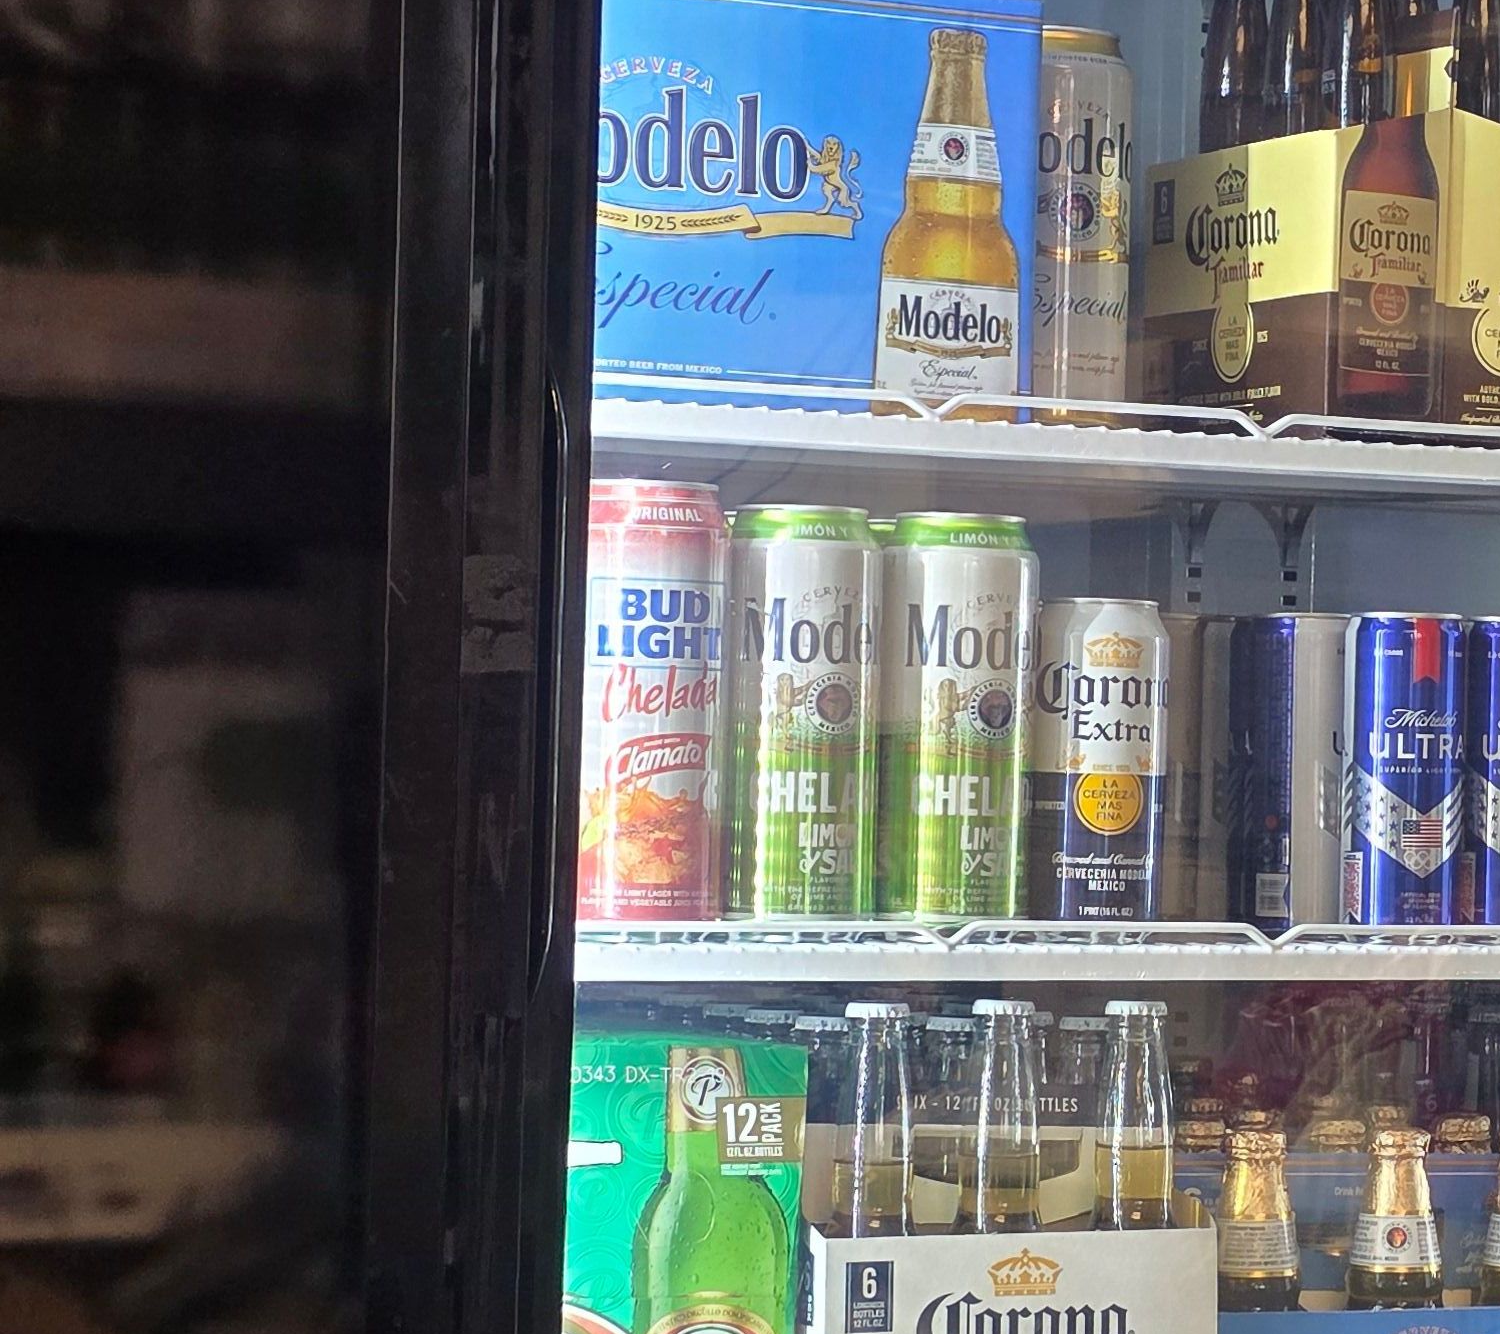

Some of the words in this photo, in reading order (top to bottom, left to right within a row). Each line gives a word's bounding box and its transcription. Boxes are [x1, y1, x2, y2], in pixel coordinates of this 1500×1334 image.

[597, 86, 811, 201] odelo
[1160, 186, 1169, 215] 6
[633, 213, 678, 232] 1925
[1185, 204, 1280, 267] Corona
[1349, 217, 1431, 257] Corona
[1211, 255, 1265, 305] Familiar
[1369, 252, 1422, 278] Familiar
[898, 293, 1001, 345] Modelo
[949, 530, 994, 545] LIMÓN
[620, 587, 712, 624] BUD
[596, 623, 721, 661] LIGHT
[602, 662, 718, 723] Chelada
[1071, 708, 1152, 742] Extra
[1384, 708, 1458, 729] Michelob
[615, 738, 702, 780] Clamato
[1368, 731, 1465, 761] ULTRA
[1082, 789, 1137, 800] CERVEZA
[1102, 778, 1119, 789] LA
[1095, 811, 1123, 822] FINA
[1096, 801, 1123, 811] MAS
[1087, 879, 1126, 892] MEXICO
[722, 1102, 759, 1144] 12
[759, 1102, 783, 1145] PACK
[861, 1266, 877, 1299] 6
[852, 1309, 885, 1320] BOTTLES
